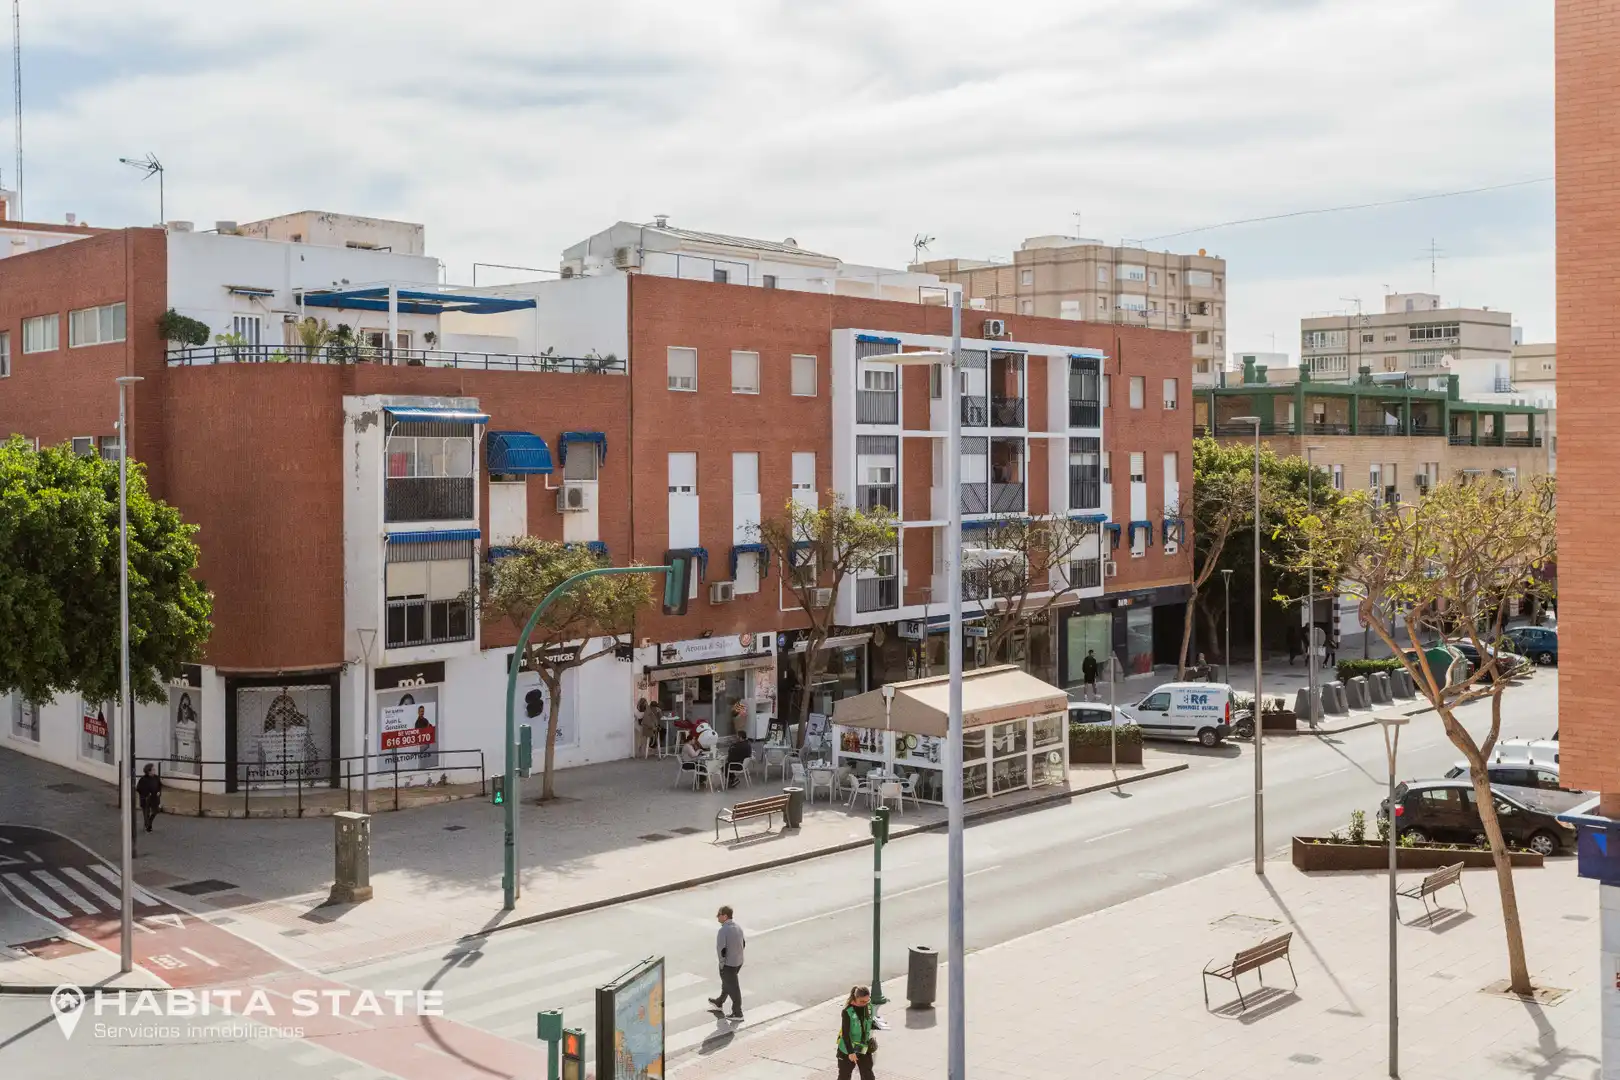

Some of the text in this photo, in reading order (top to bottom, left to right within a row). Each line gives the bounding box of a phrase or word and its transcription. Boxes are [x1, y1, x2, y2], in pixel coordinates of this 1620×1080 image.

[685, 643, 708, 653] Aroma
[385, 718, 398, 726] Juan
[386, 737, 401, 747] 616
[401, 735, 416, 745] 903
[417, 733, 431, 743] 170
